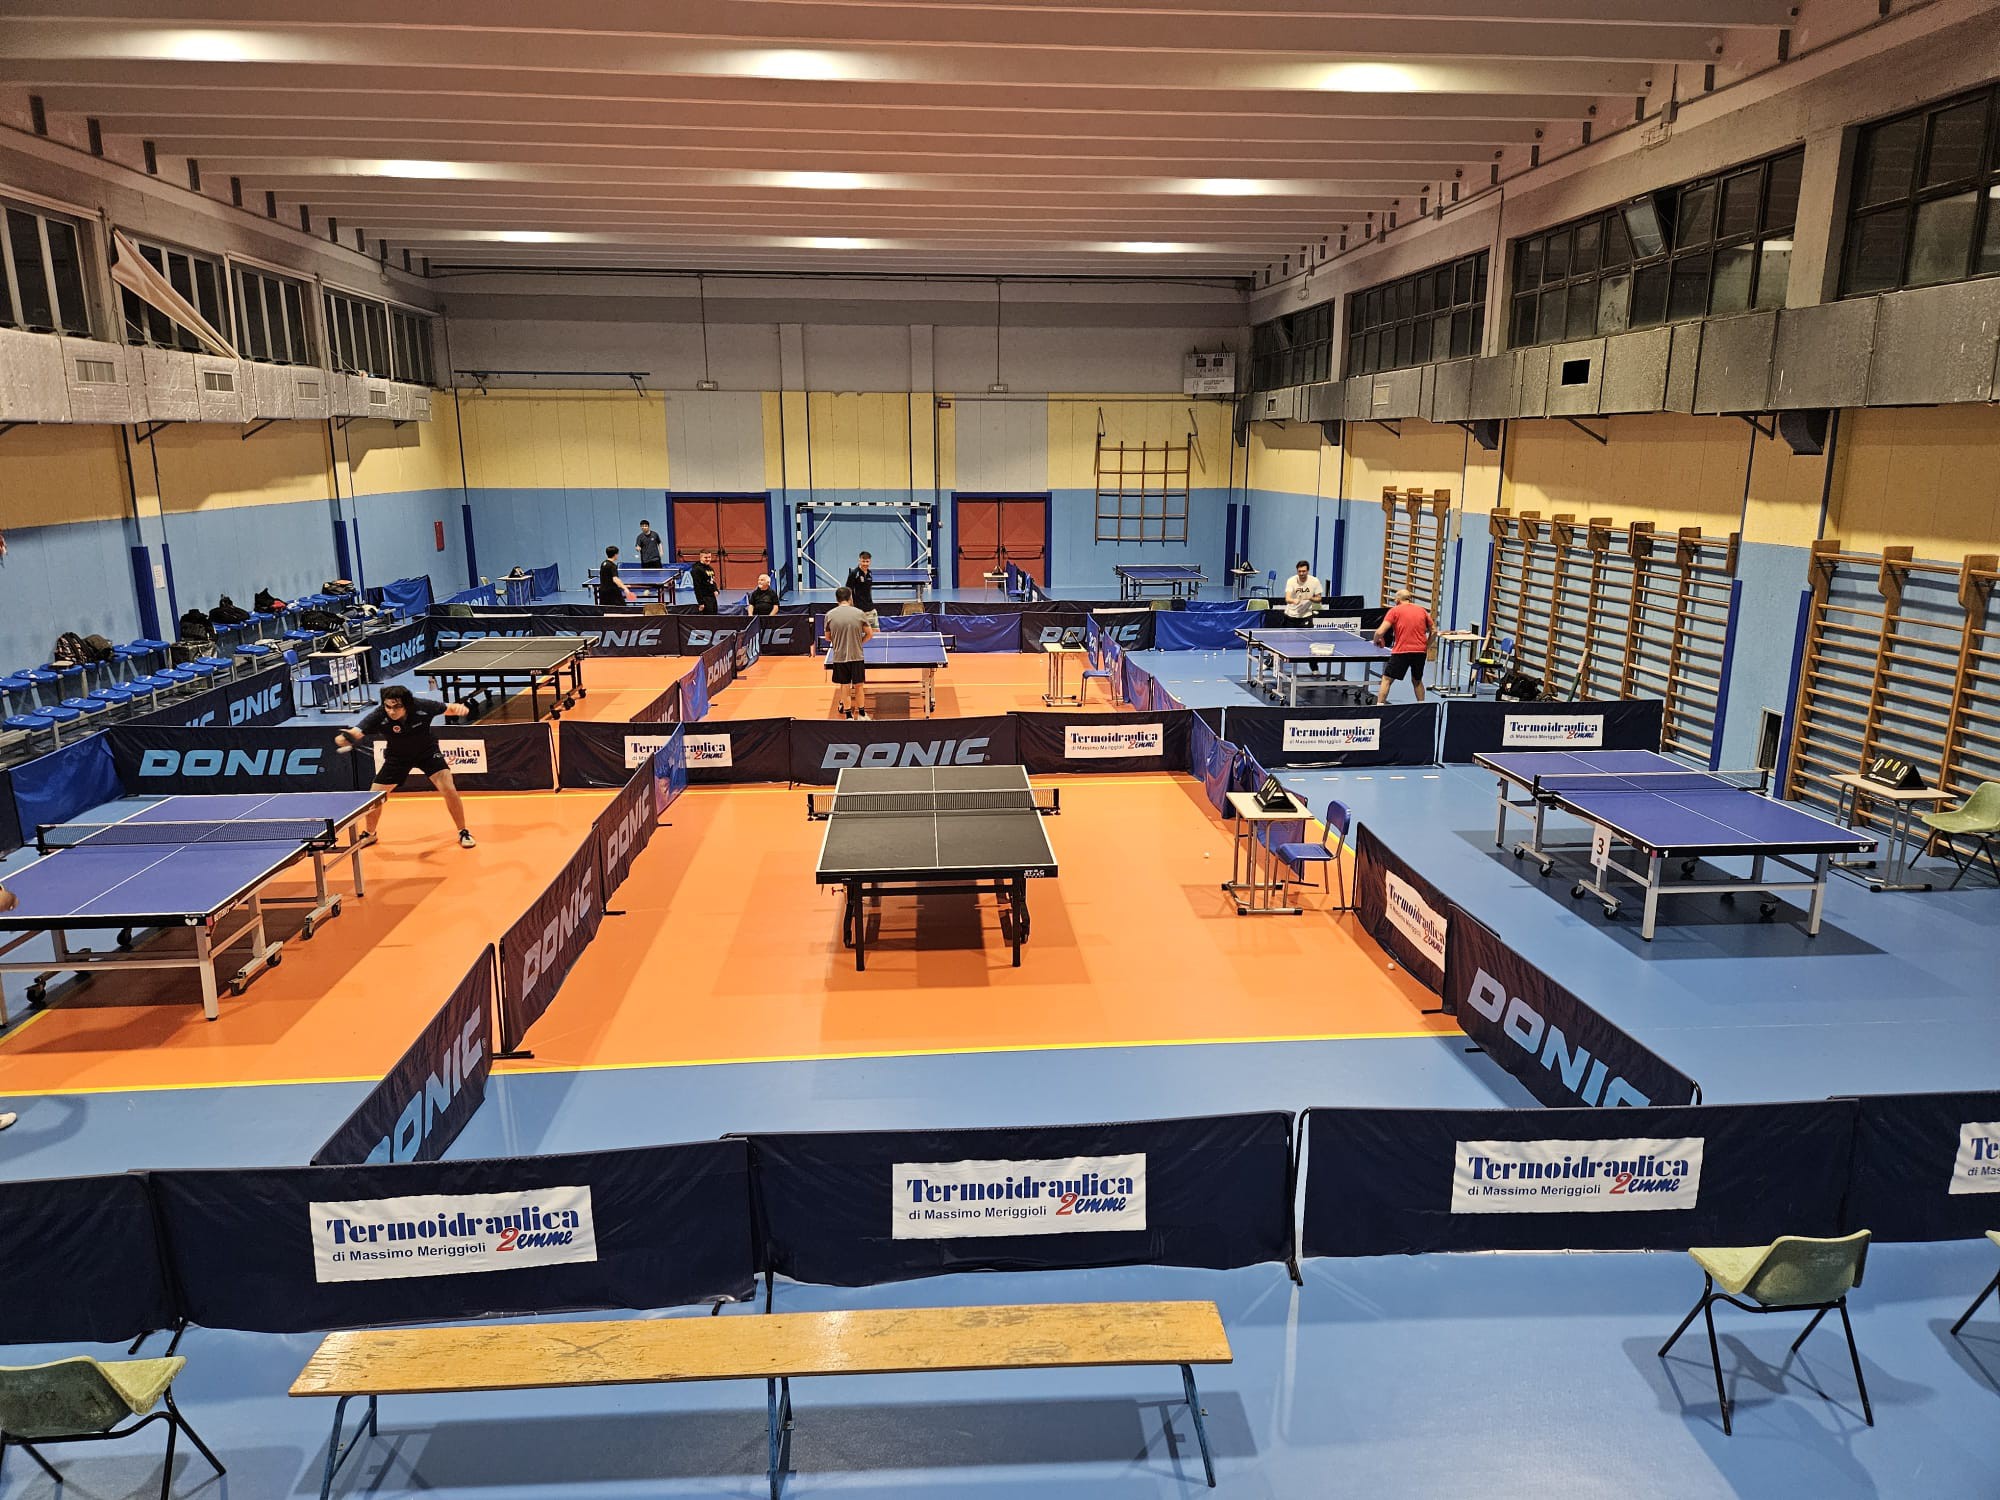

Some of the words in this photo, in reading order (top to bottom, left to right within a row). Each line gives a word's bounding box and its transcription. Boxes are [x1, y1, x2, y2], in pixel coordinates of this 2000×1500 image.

[688, 628, 793, 646] DOIC
[1039, 624, 1141, 643] DOIC
[379, 634, 425, 669] DONIC
[1071, 731, 1158, 743] Termoidraulica
[1290, 726, 1375, 737] Termoidraulica
[1510, 721, 1598, 732] Termoidraulica
[138, 748, 322, 777] DONIC
[820, 737, 990, 769] DONIC
[607, 784, 650, 875] DONIC
[1597, 837, 1605, 855] 3
[522, 866, 592, 1001] DONIC
[1468, 1155, 1689, 1180] Termoidraulica
[1967, 1166, 1978, 1176] di
[907, 1173, 1134, 1203] Termoidraulica
[1467, 1185, 1479, 1195] di
[1483, 1185, 1537, 1196] Massimo
[1541, 1184, 1600, 1197] Meriggioli
[1609, 1172, 1681, 1194] 2emme
[908, 1210, 921, 1220] di
[924, 1207, 981, 1219] Massimo
[985, 1205, 1047, 1219] Meriggioli
[1055, 1192, 1126, 1216] 2emme
[326, 1205, 579, 1245] Termoidraulica
[496, 1227, 573, 1252] 2emme
[332, 1251, 345, 1262] di
[350, 1248, 413, 1261] Massimo
[418, 1242, 486, 1258] Meriggioli
